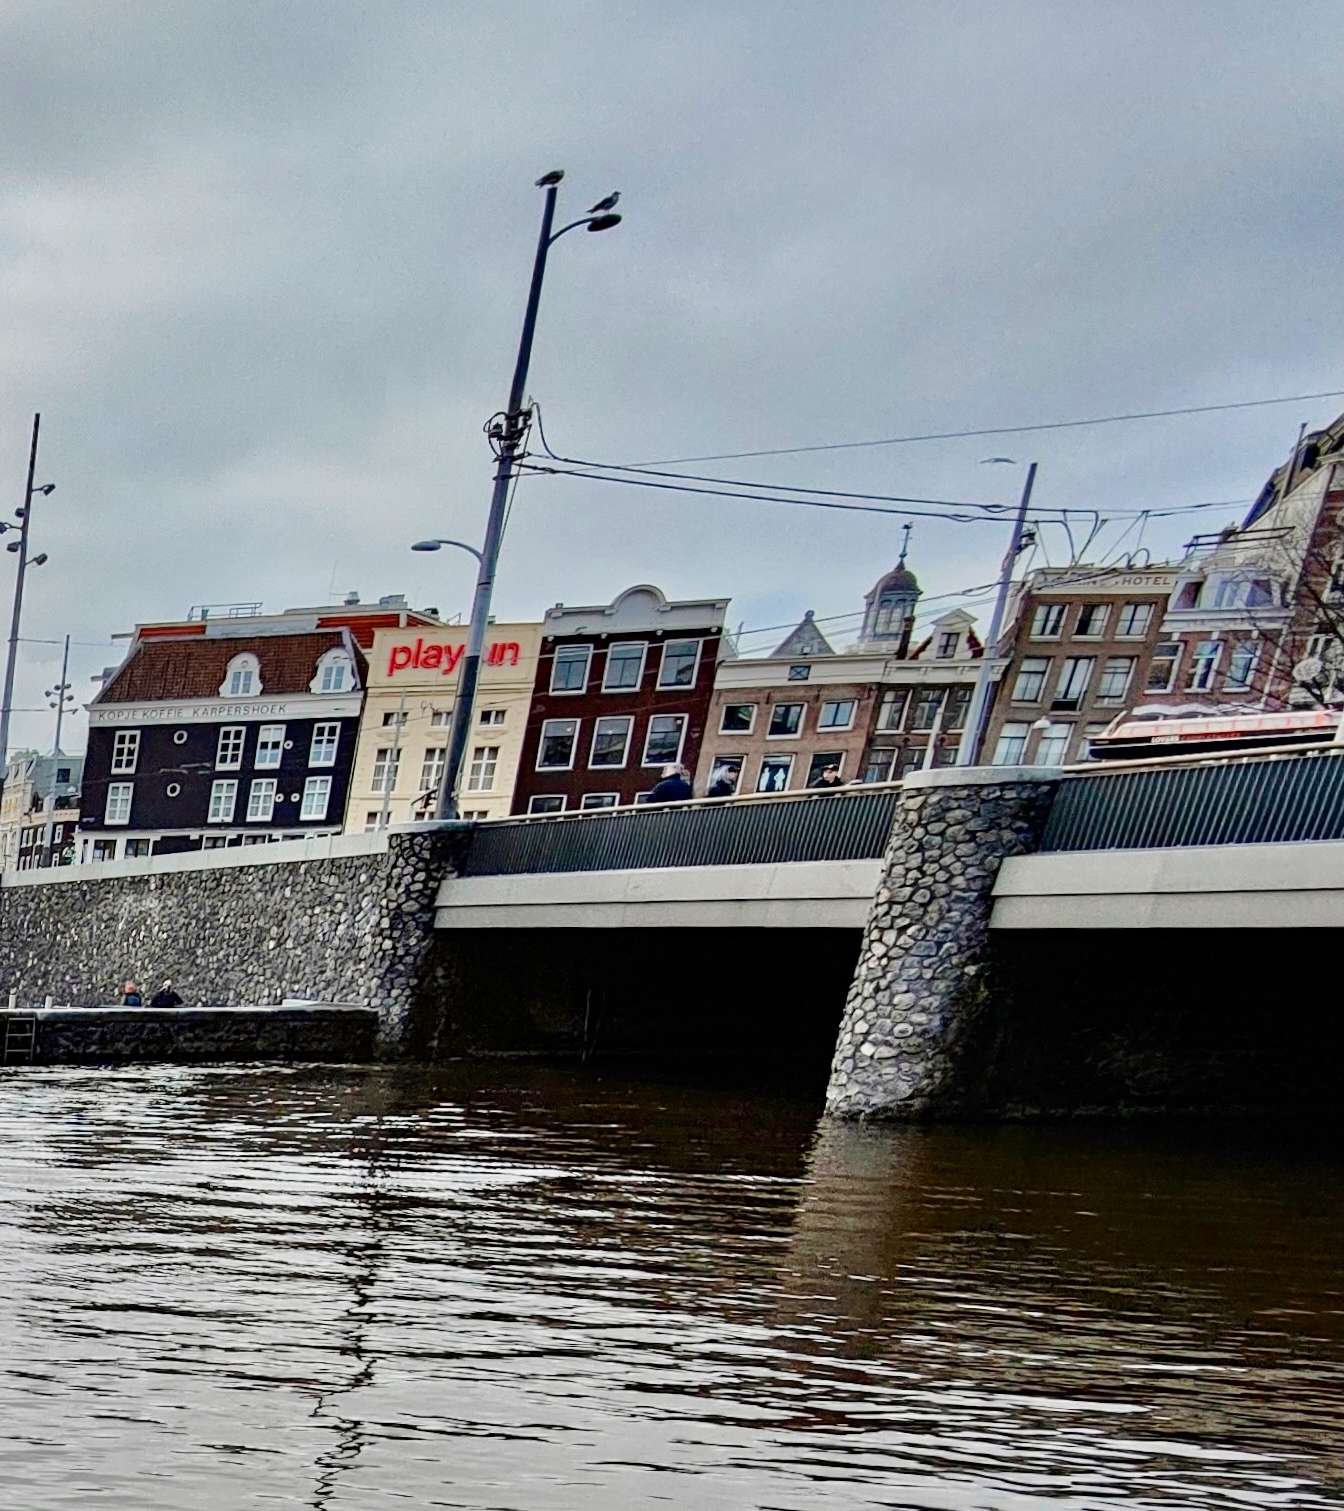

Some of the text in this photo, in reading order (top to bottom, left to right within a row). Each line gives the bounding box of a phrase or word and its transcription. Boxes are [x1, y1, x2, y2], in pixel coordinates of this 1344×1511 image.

[1121, 576, 1172, 586] HOTEL
[98, 704, 288, 721] KOPJE KOFFIE KARPERSHOEK
